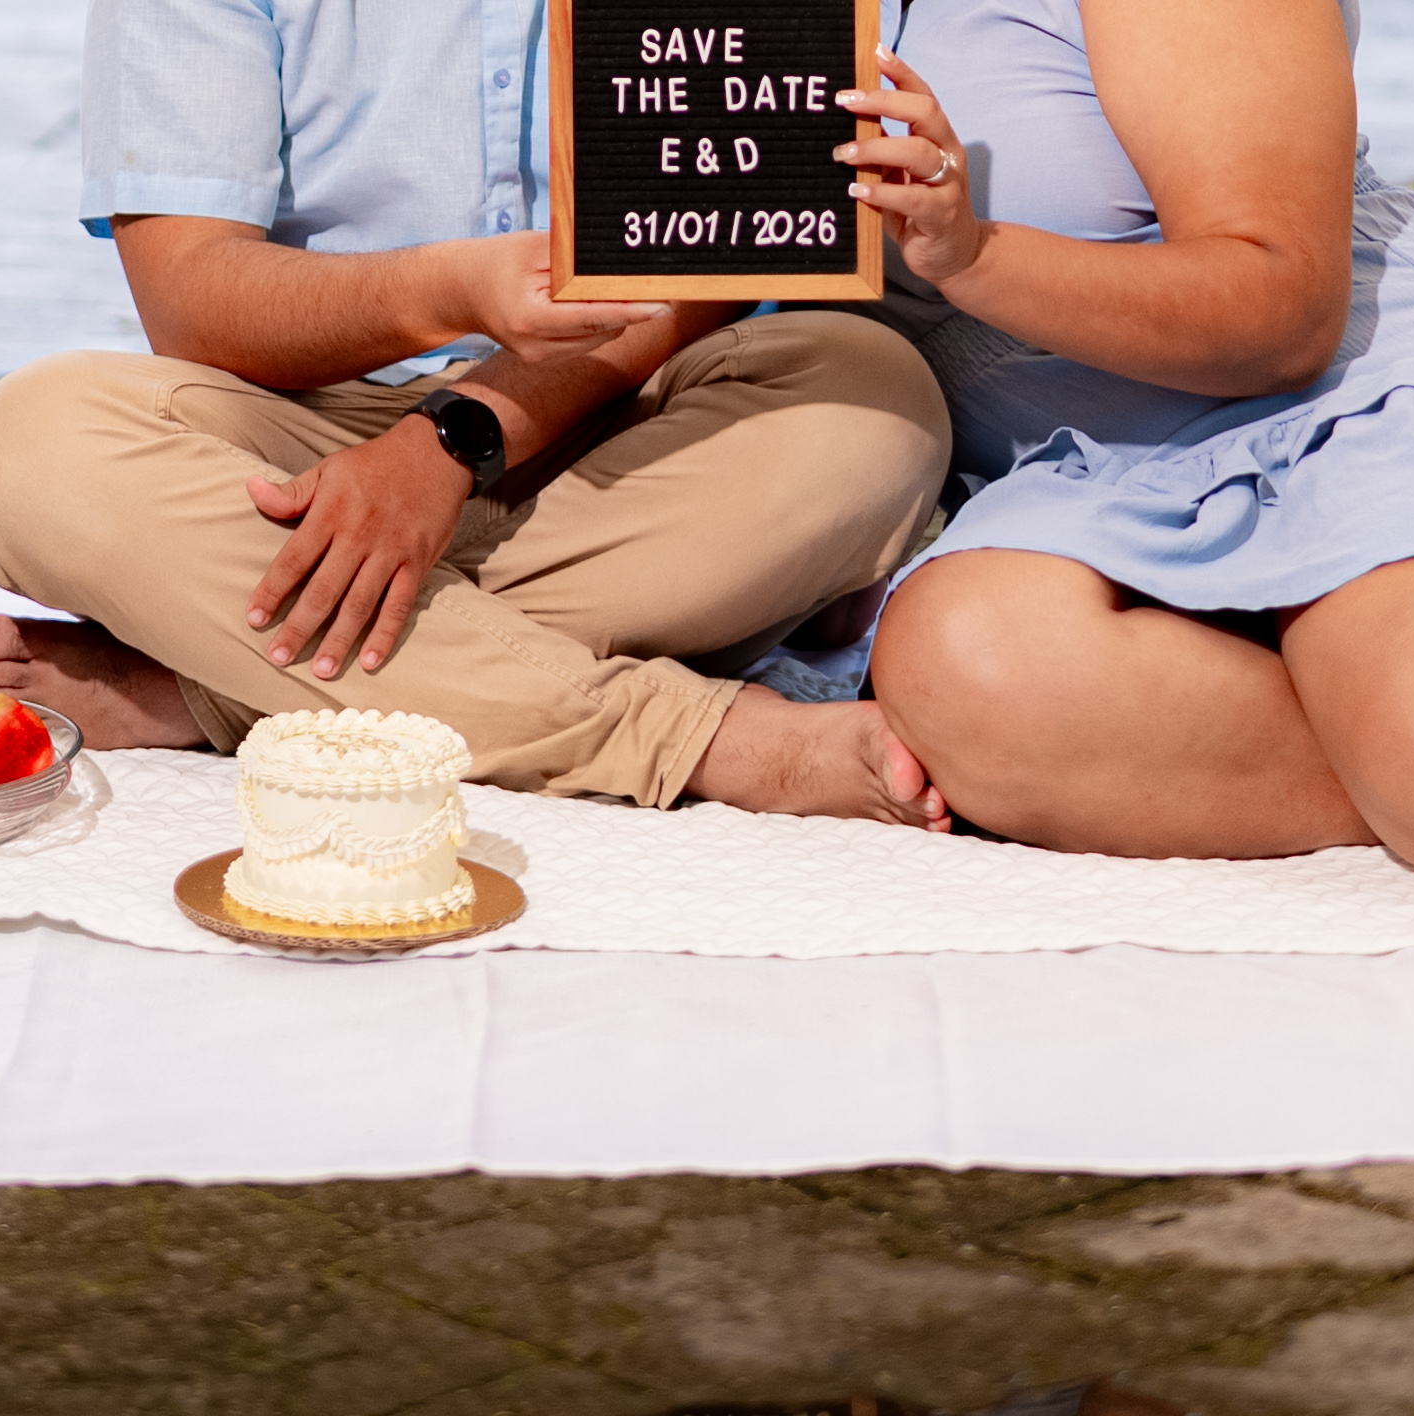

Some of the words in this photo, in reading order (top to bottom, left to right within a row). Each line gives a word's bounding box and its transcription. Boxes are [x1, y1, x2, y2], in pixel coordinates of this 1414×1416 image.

[640, 27, 745, 64] SAVE
[611, 76, 690, 114] THE
[724, 74, 828, 112] DATE
